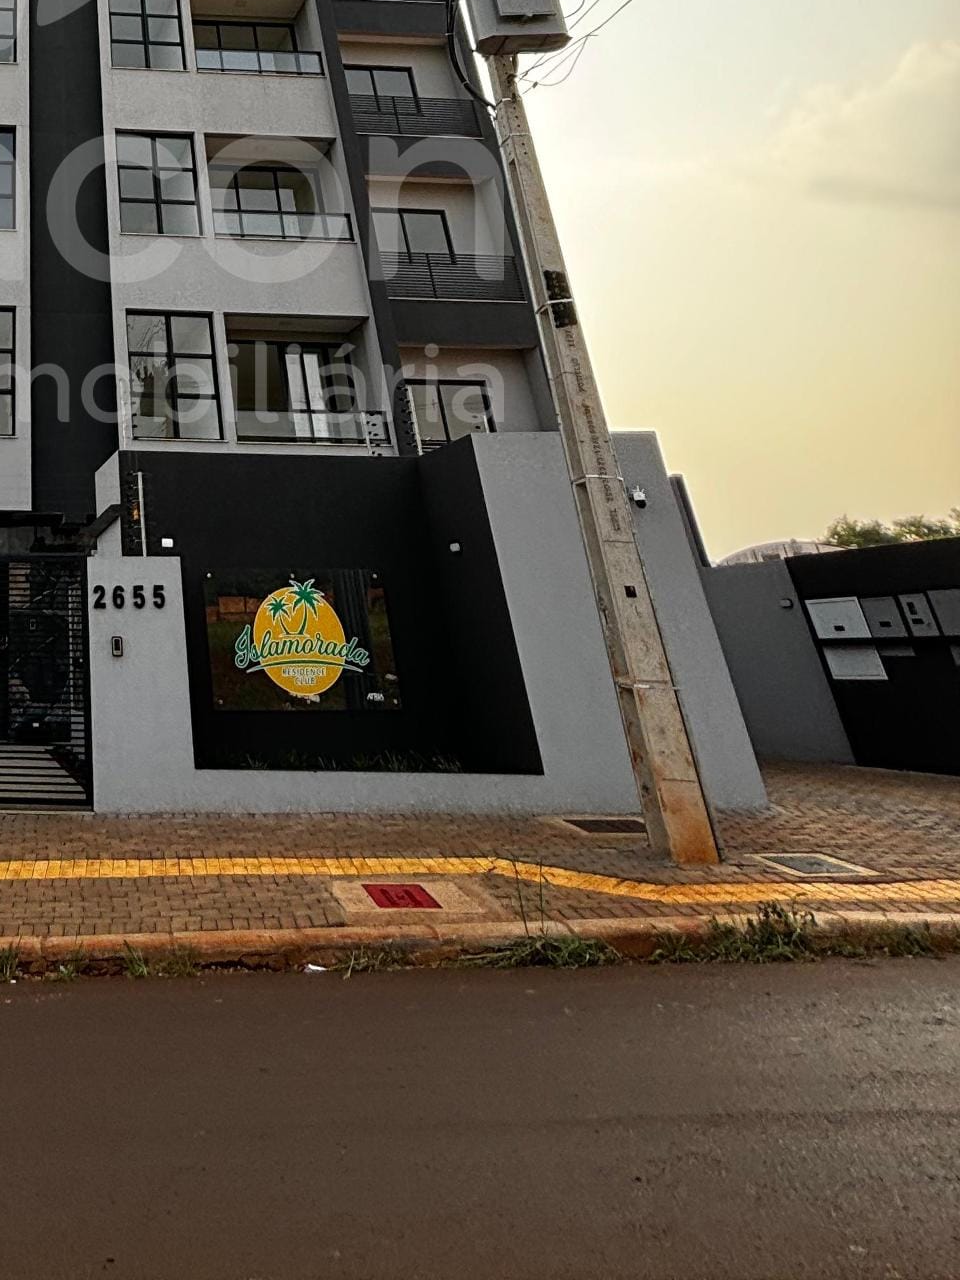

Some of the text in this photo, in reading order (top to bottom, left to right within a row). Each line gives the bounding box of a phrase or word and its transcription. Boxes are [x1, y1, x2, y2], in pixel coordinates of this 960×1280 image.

[93, 584, 166, 609] 2655
[234, 623, 371, 669] Islamorada
[281, 666, 327, 677] RESIDENCE
